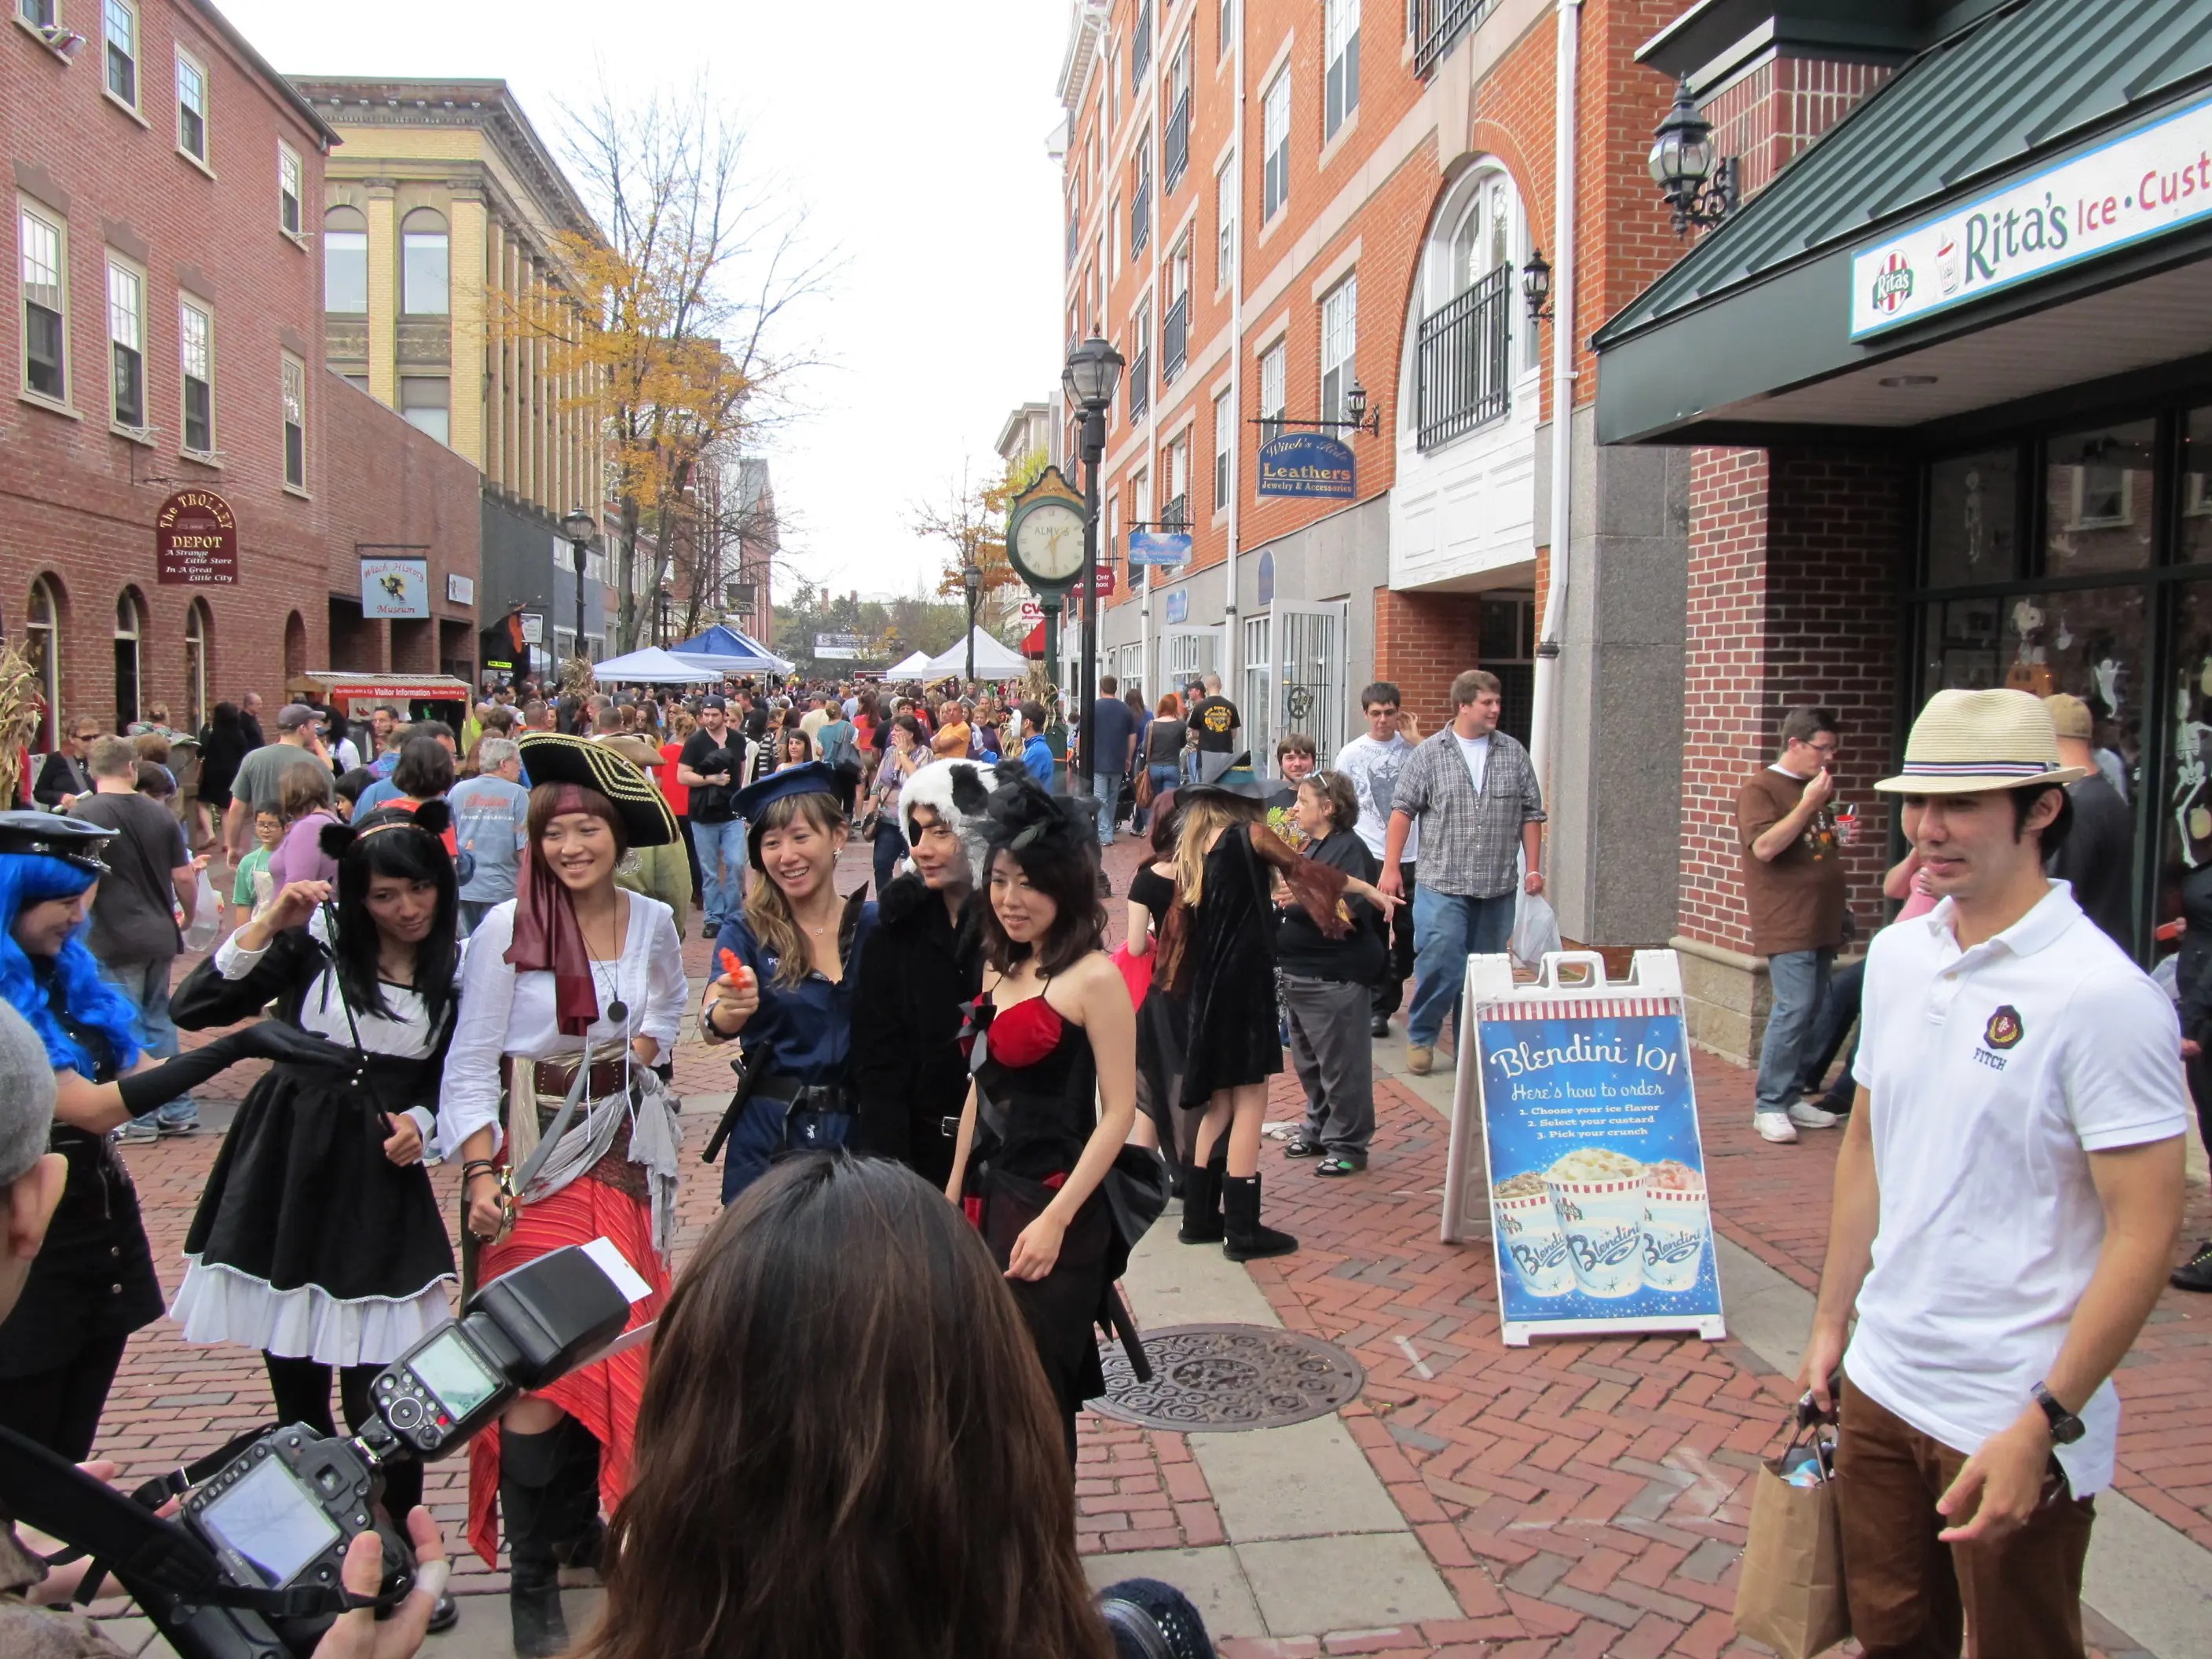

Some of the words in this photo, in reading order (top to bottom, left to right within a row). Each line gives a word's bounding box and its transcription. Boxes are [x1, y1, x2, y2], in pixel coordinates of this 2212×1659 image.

[1965, 191, 2068, 285] Rita's
[2078, 196, 2118, 236] Ice
[1878, 269, 1910, 298] Rita's
[1266, 438, 1312, 457] Witch's
[1263, 463, 1351, 480] Leathers
[1262, 481, 1293, 491] Jewelry
[1295, 482, 1302, 491] &
[1305, 482, 1351, 493] Accessories
[160, 507, 178, 528] The
[178, 493, 233, 529] TROLLEY
[172, 536, 222, 548] DEPOT
[214, 574, 233, 583] City
[364, 563, 388, 578] Witch
[393, 562, 424, 583] History
[377, 605, 416, 613] Museum
[1021, 602, 1042, 614] CV
[374, 687, 395, 697] Visitor
[396, 688, 430, 698] Information
[1490, 1034, 1628, 1079] Blendini
[1636, 1043, 1677, 1075] 101
[1972, 1047, 2007, 1071] FITCH
[1511, 1082, 1562, 1101] Here's
[1566, 1081, 1596, 1099] how
[1602, 1082, 1617, 1097] to
[1621, 1079, 1664, 1097] order
[1532, 1107, 1573, 1115] Choose
[1576, 1107, 1602, 1115] your
[1609, 1115, 1654, 1124] custard
[1578, 1130, 1605, 1138] your
[1607, 1127, 1648, 1136] crunch
[1511, 1231, 1564, 1276] Blendi
[1566, 1221, 1641, 1273] Blendini
